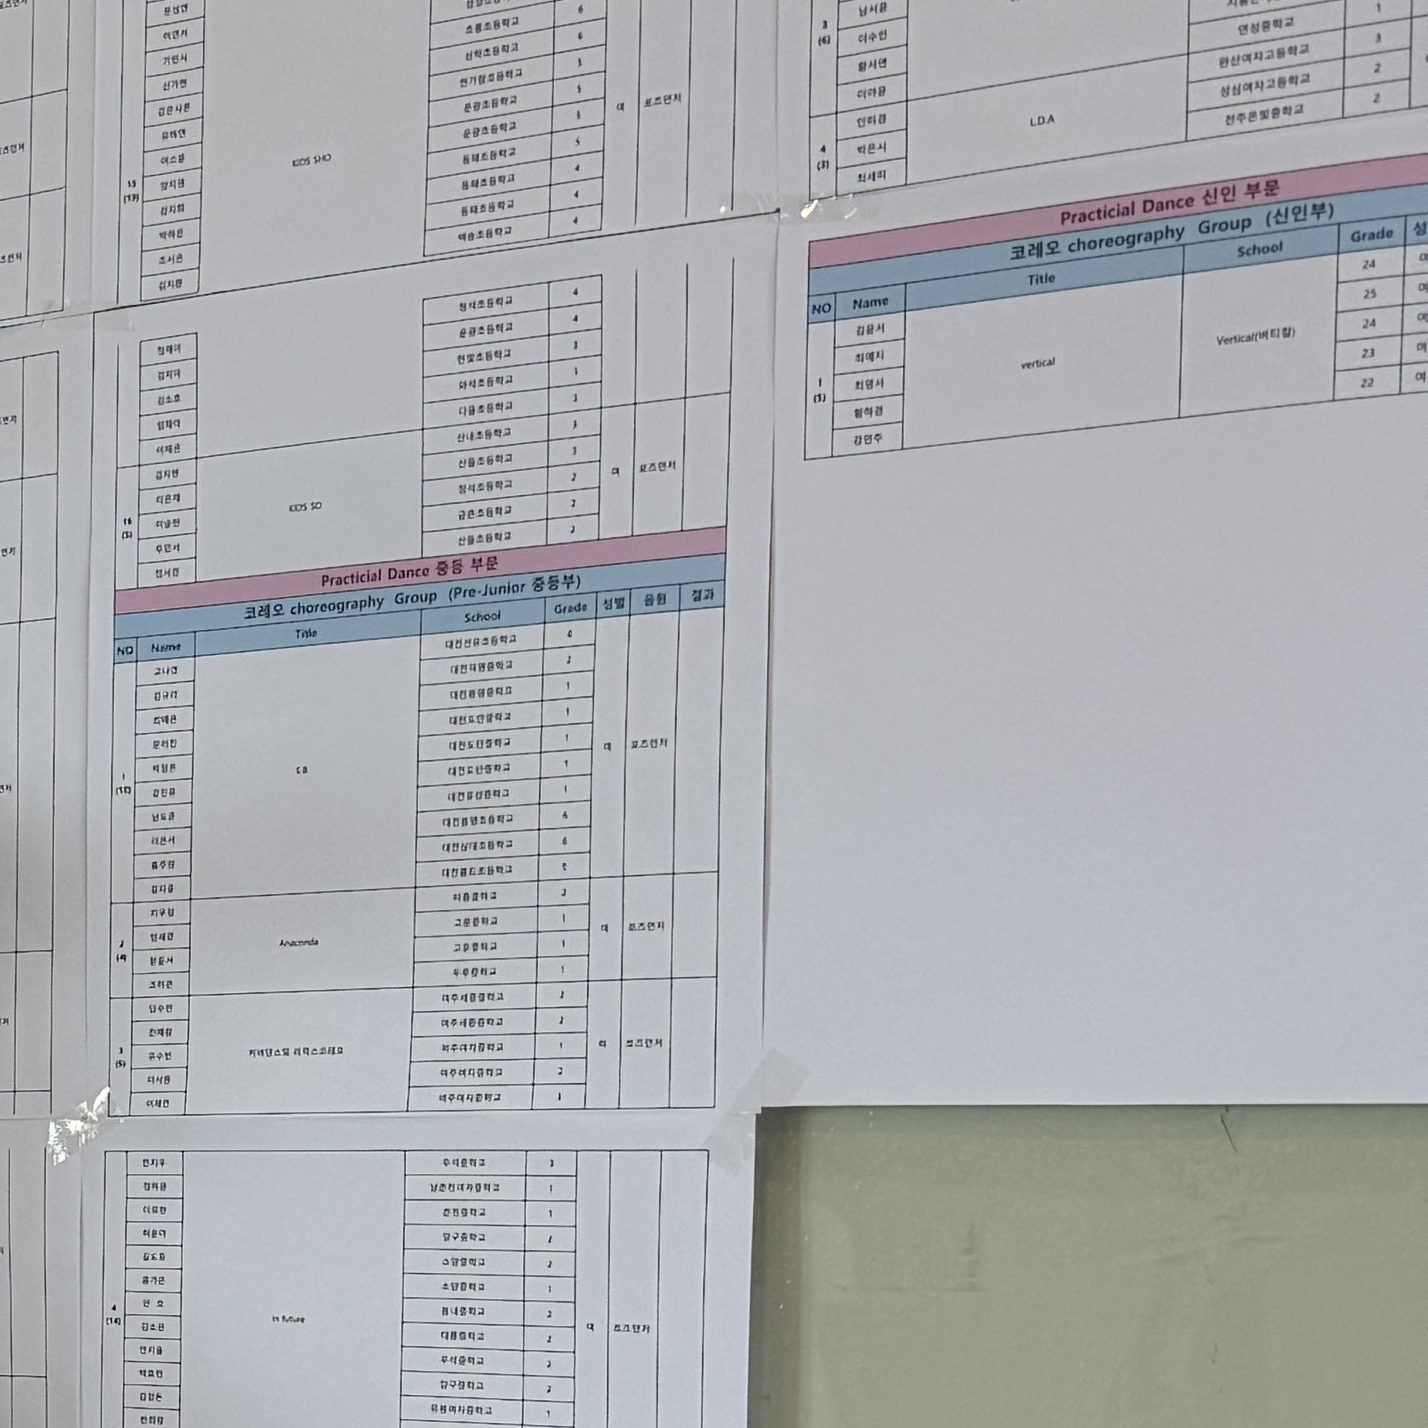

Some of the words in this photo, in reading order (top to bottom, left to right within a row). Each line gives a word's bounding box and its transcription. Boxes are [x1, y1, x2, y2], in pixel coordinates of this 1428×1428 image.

[1374, 64, 1381, 73] 2
[1373, 93, 1380, 103] 2
[1060, 201, 1135, 226] Practicial
[1142, 197, 1194, 214] Dance
[1202, 185, 1236, 206] 신인
[1244, 180, 1280, 199] 부문
[1011, 240, 1061, 260] 코레오
[1067, 222, 1185, 253] choreography
[1198, 216, 1252, 235] Group
[1265, 202, 1334, 228] (신인부)
[1362, 260, 1376, 269] 24
[812, 303, 832, 316] NO
[853, 296, 889, 310] Name
[1028, 272, 1055, 286] Title
[1238, 241, 1283, 257] School
[1351, 227, 1393, 242] Grade
[1364, 289, 1377, 299] 25
[1362, 319, 1376, 328] 24
[1361, 349, 1374, 358] 23
[1021, 358, 1055, 370] vertical
[1361, 378, 1374, 388] 22
[321, 568, 381, 588] Practicial
[388, 566, 429, 580] Dance
[436, 559, 463, 576] 중등
[471, 556, 498, 571] 부문
[244, 603, 285, 619] 코레오
[291, 595, 384, 617] choreography
[394, 590, 437, 604] Group
[448, 580, 526, 602] (Pre-Junior
[531, 575, 581, 591] 중등부)
[117, 646, 133, 655] NO
[151, 643, 181, 653] Name
[295, 628, 317, 638] Title
[464, 612, 501, 622] School
[554, 603, 587, 614] Grade
